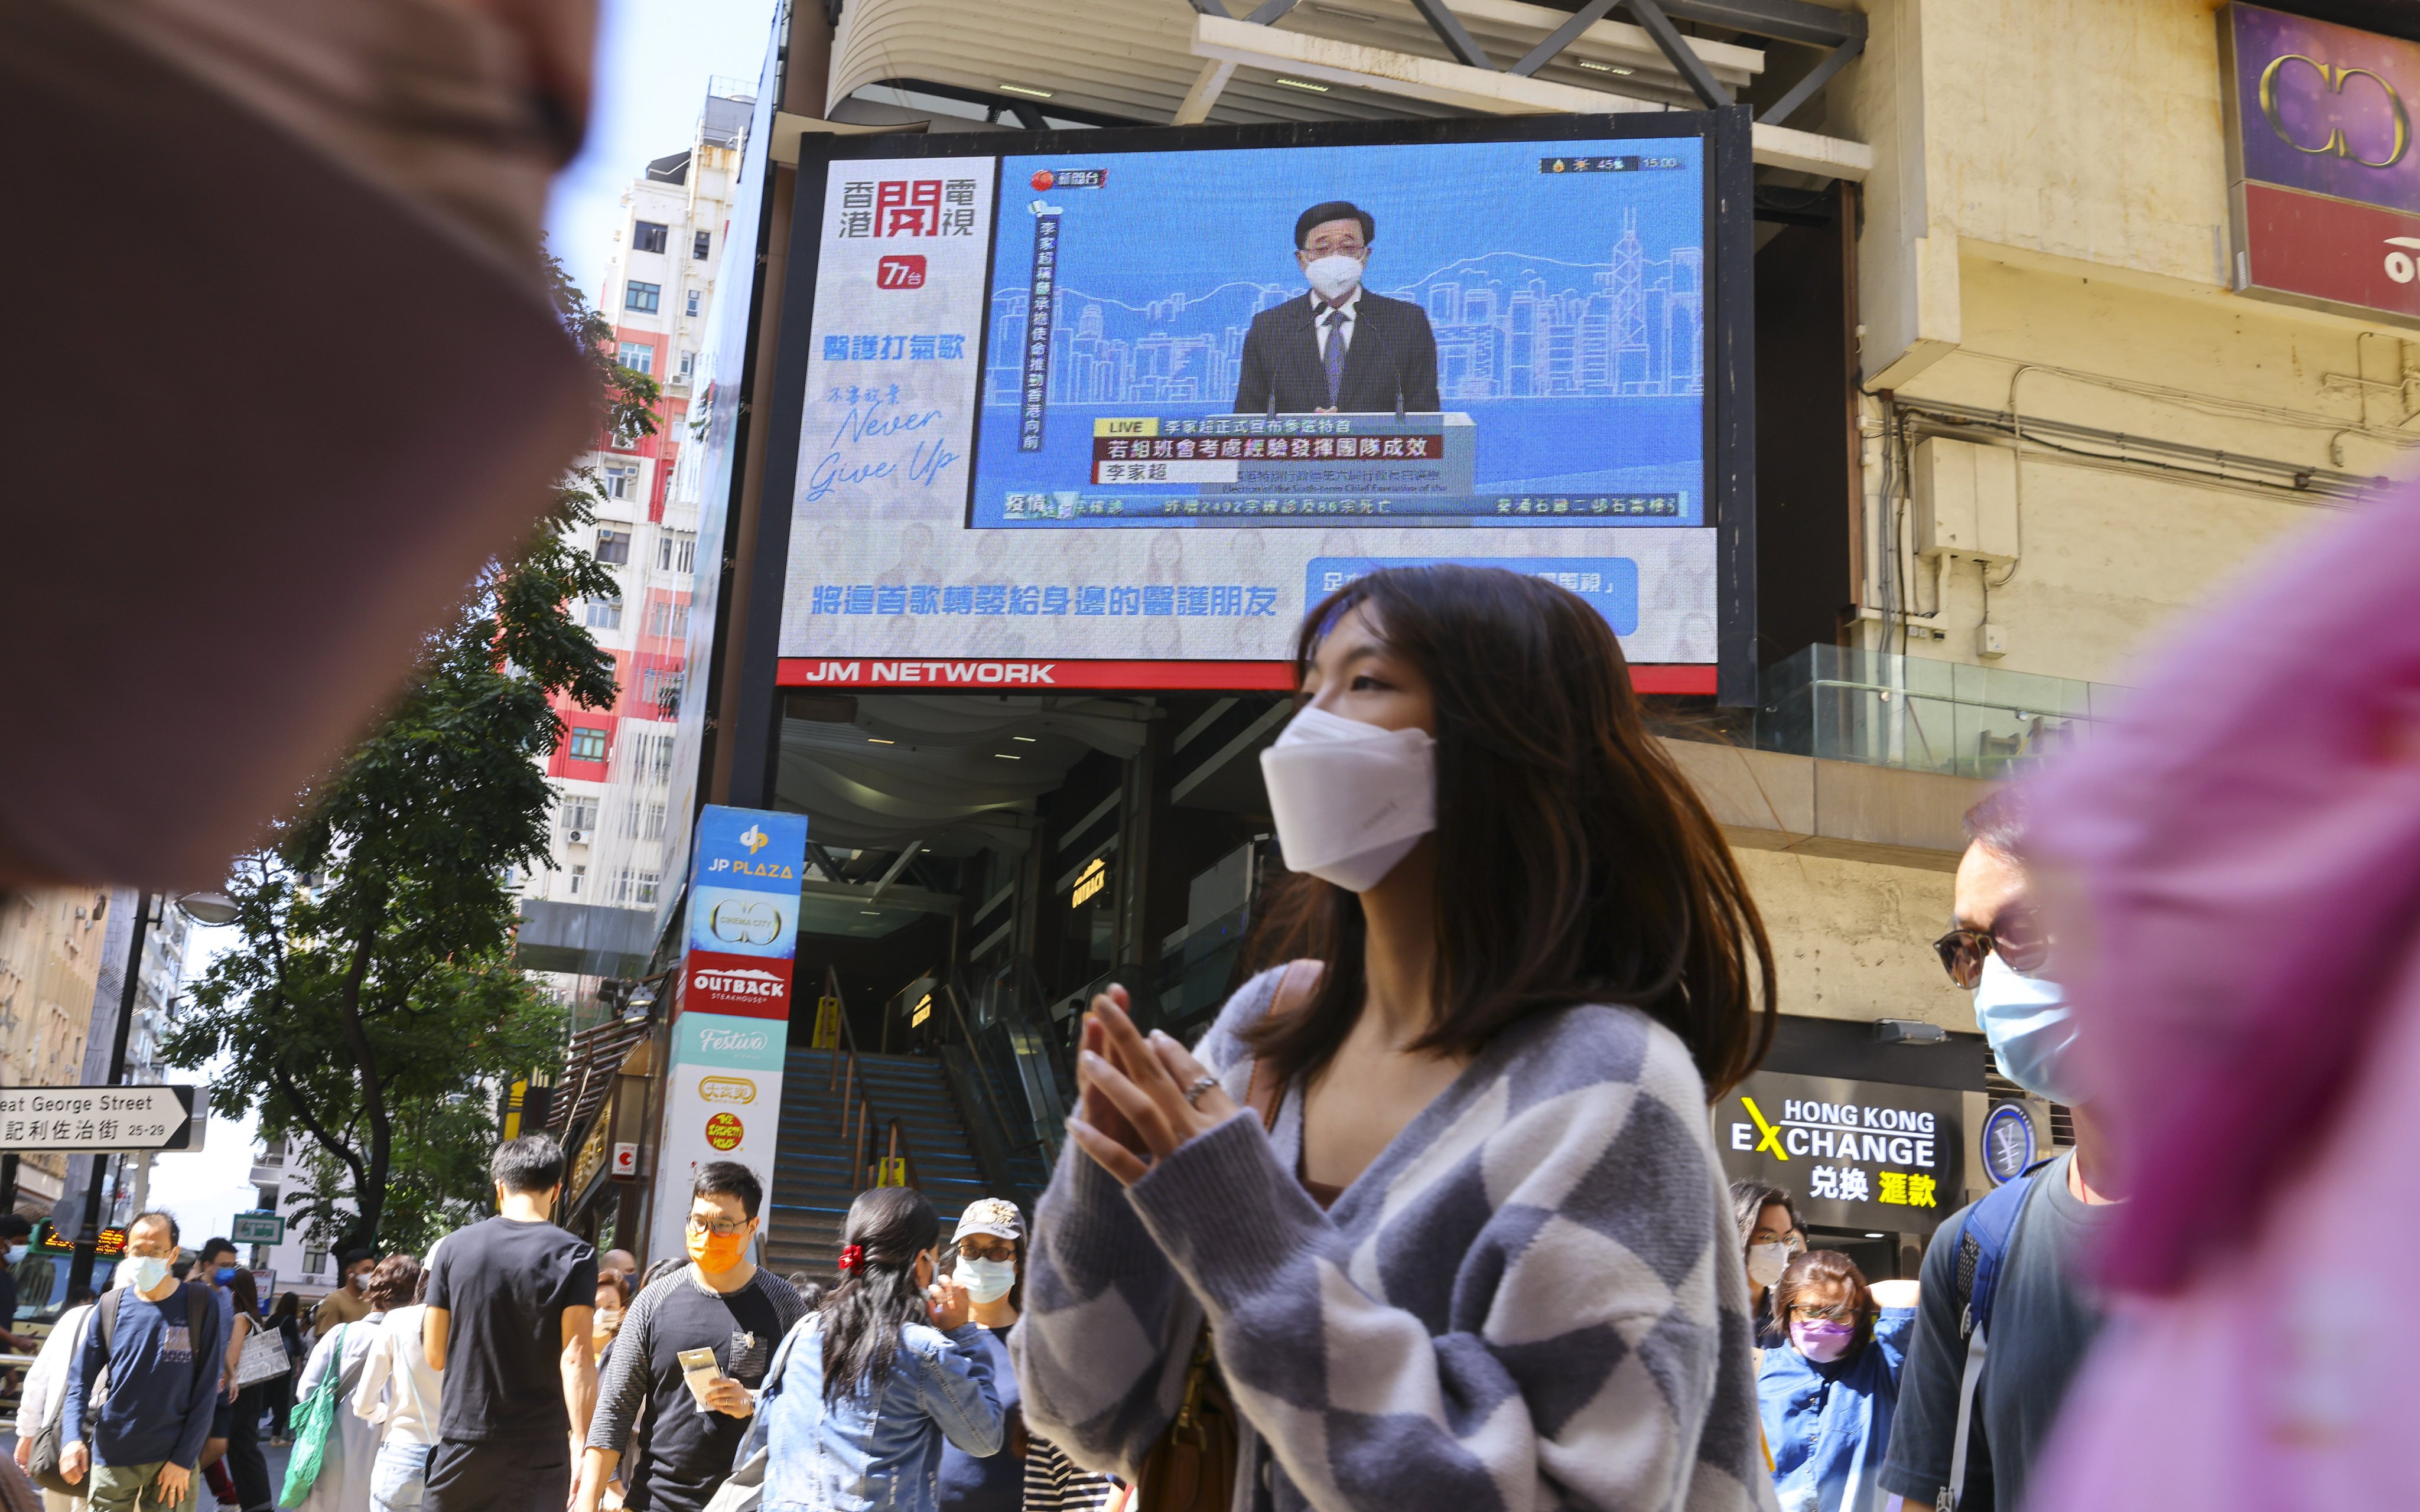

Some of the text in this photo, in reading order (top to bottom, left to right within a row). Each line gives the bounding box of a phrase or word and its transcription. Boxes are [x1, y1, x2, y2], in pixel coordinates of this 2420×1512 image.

[823, 334, 966, 361] 醫護打氣歌
[831, 400, 942, 449] Never
[1110, 420, 1143, 434] LIVE
[1107, 437, 1429, 459] 若組班會考慮經驗發揮團隊成效
[806, 438, 961, 502] Give Up
[1105, 462, 1167, 481] 李家超
[811, 584, 1277, 616] 將這首歌轉發給身邊的醫護朋友
[806, 662, 1056, 684] JM NETWORK
[708, 858, 793, 879] JP PLAZA
[719, 915, 772, 928] CINEMA CITY
[694, 975, 785, 998] OUTBACK
[700, 1028, 769, 1052] Festiva
[32, 1096, 93, 1115] George
[99, 1095, 154, 1111] Street
[1784, 1099, 1935, 1133] HONG KONG
[5, 1119, 165, 1141] 記利佐治街 25-29
[1731, 1097, 1936, 1168] EXCHANGE
